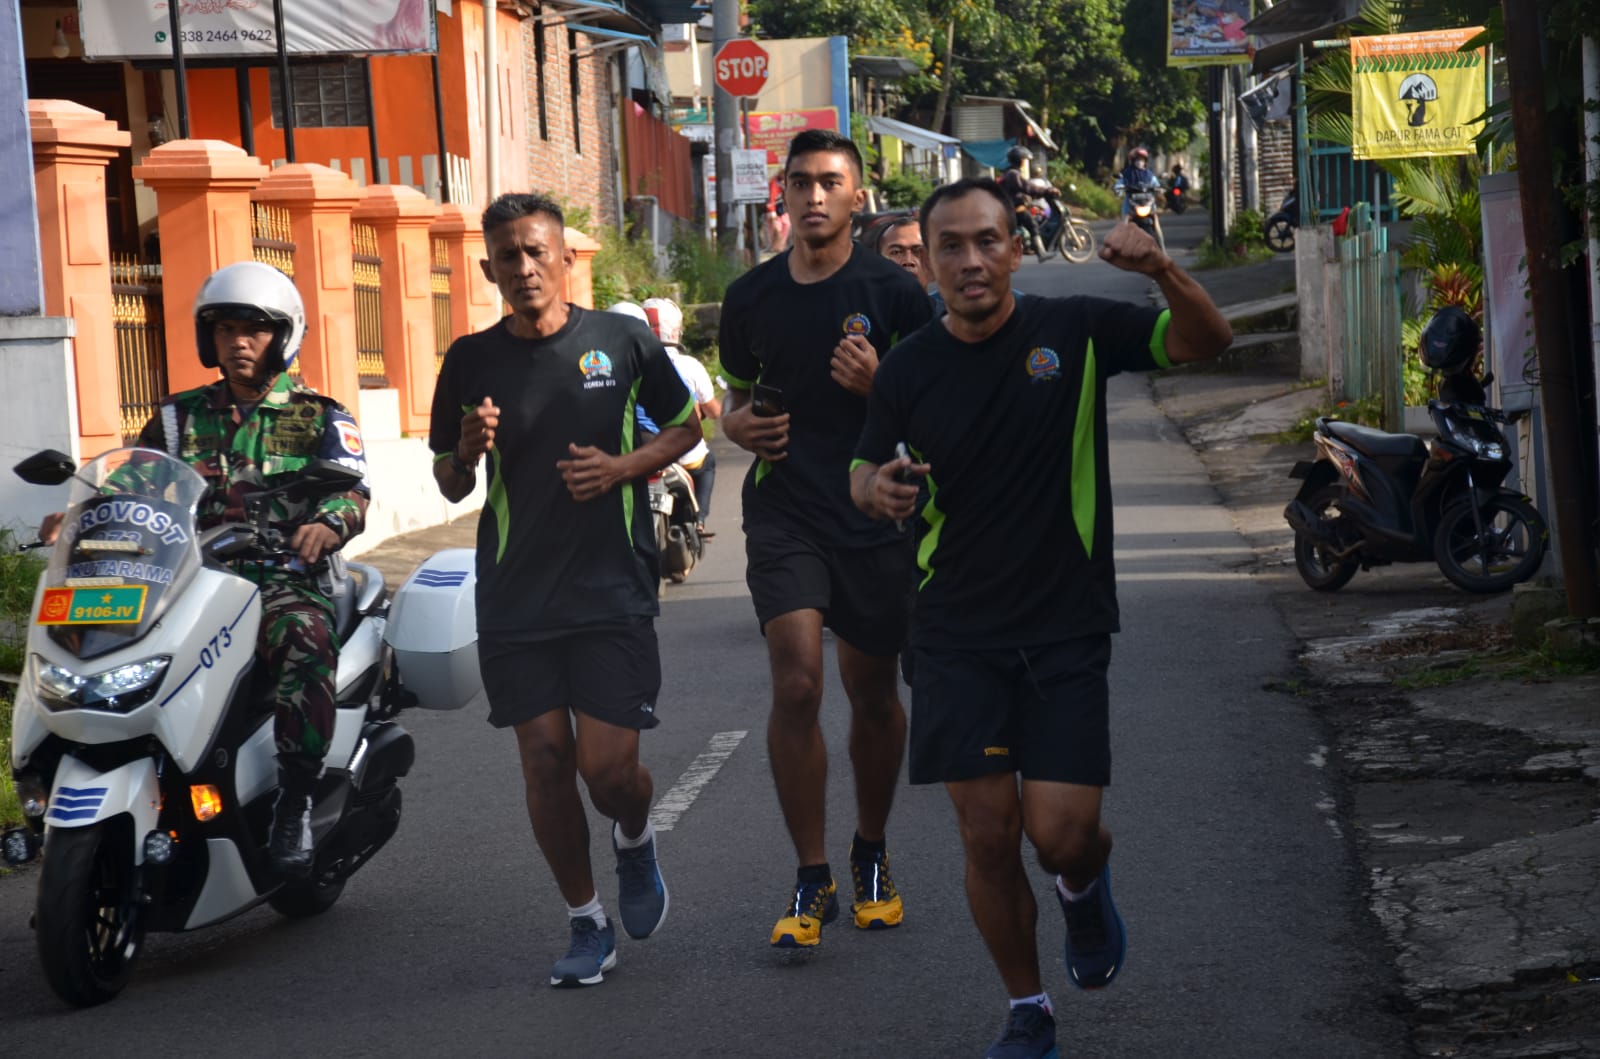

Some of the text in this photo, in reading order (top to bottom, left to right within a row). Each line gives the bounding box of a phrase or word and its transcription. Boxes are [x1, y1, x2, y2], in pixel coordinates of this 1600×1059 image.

[179, 30, 272, 42] 838 2464 9622
[719, 56, 766, 80] STOP
[1376, 126, 1462, 143] DAPUR FAMA CAT
[66, 560, 173, 584] KUTARAMA
[74, 605, 134, 619] 9106-IV
[200, 625, 231, 669] 073
